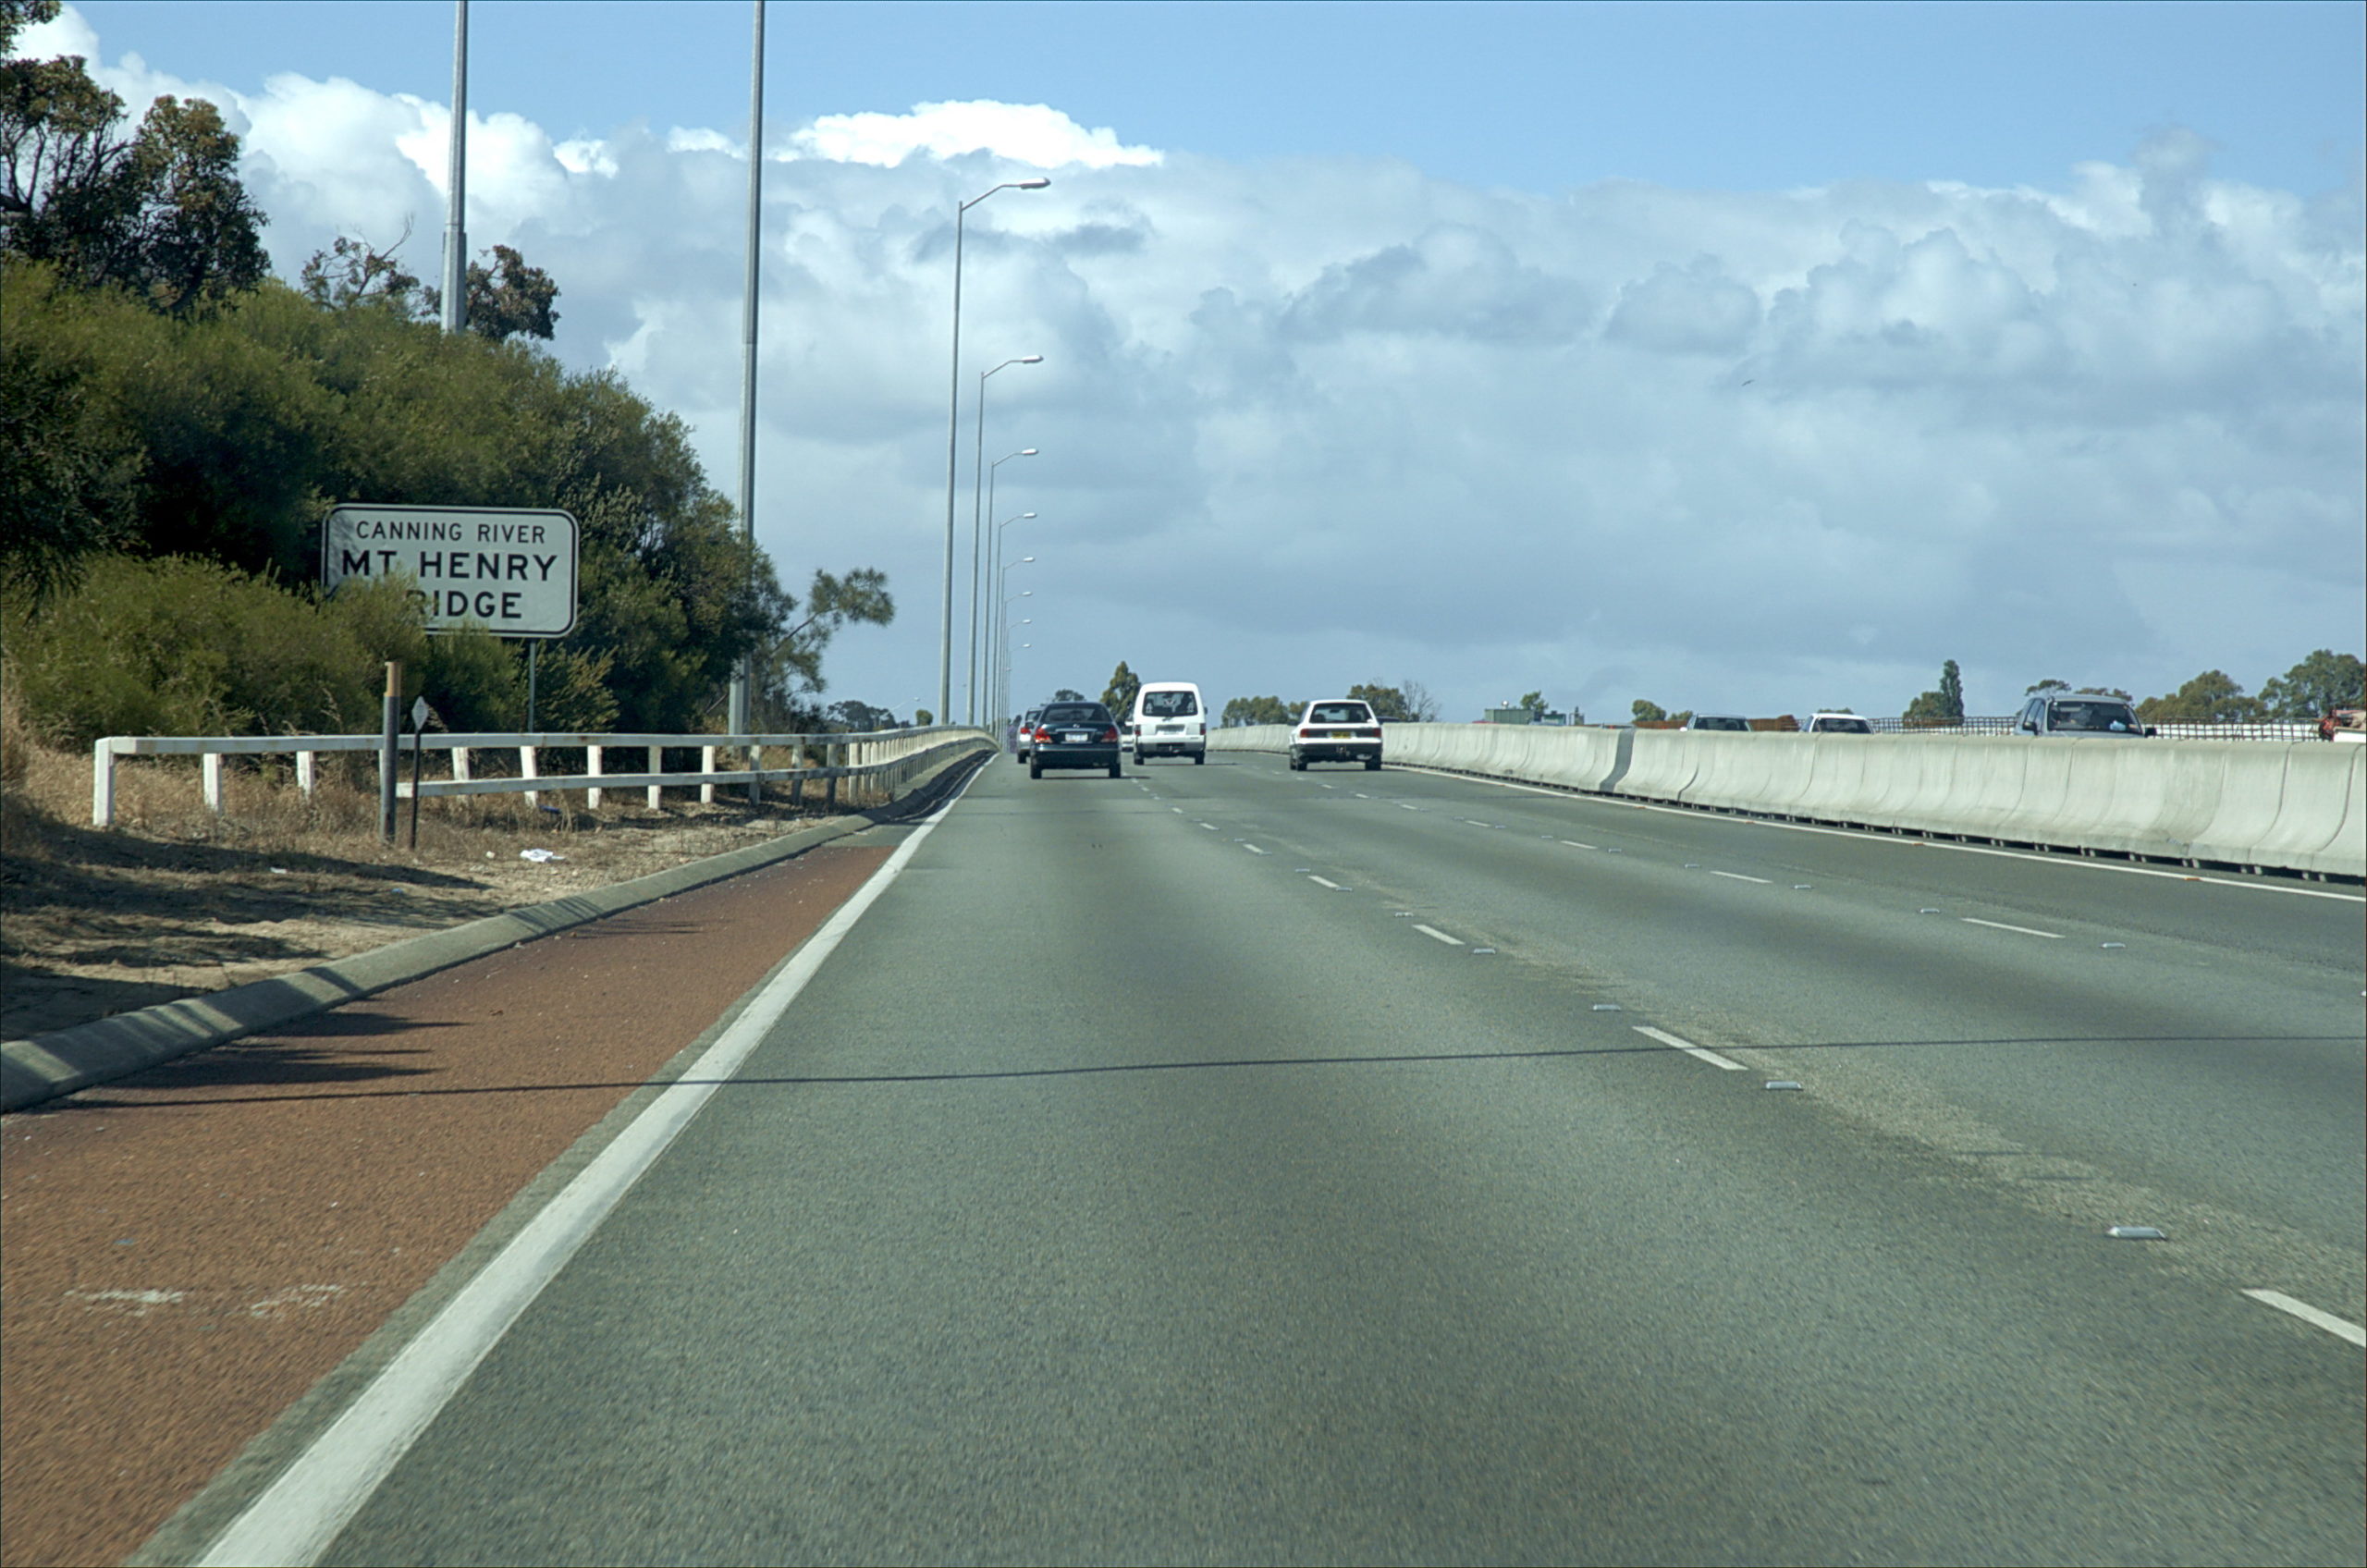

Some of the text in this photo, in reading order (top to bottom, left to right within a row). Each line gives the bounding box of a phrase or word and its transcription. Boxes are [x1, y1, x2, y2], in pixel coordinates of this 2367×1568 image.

[356, 521, 545, 544] CANNING RIVER
[342, 549, 557, 581] MT HENRY
[405, 589, 522, 619] RIDGE
